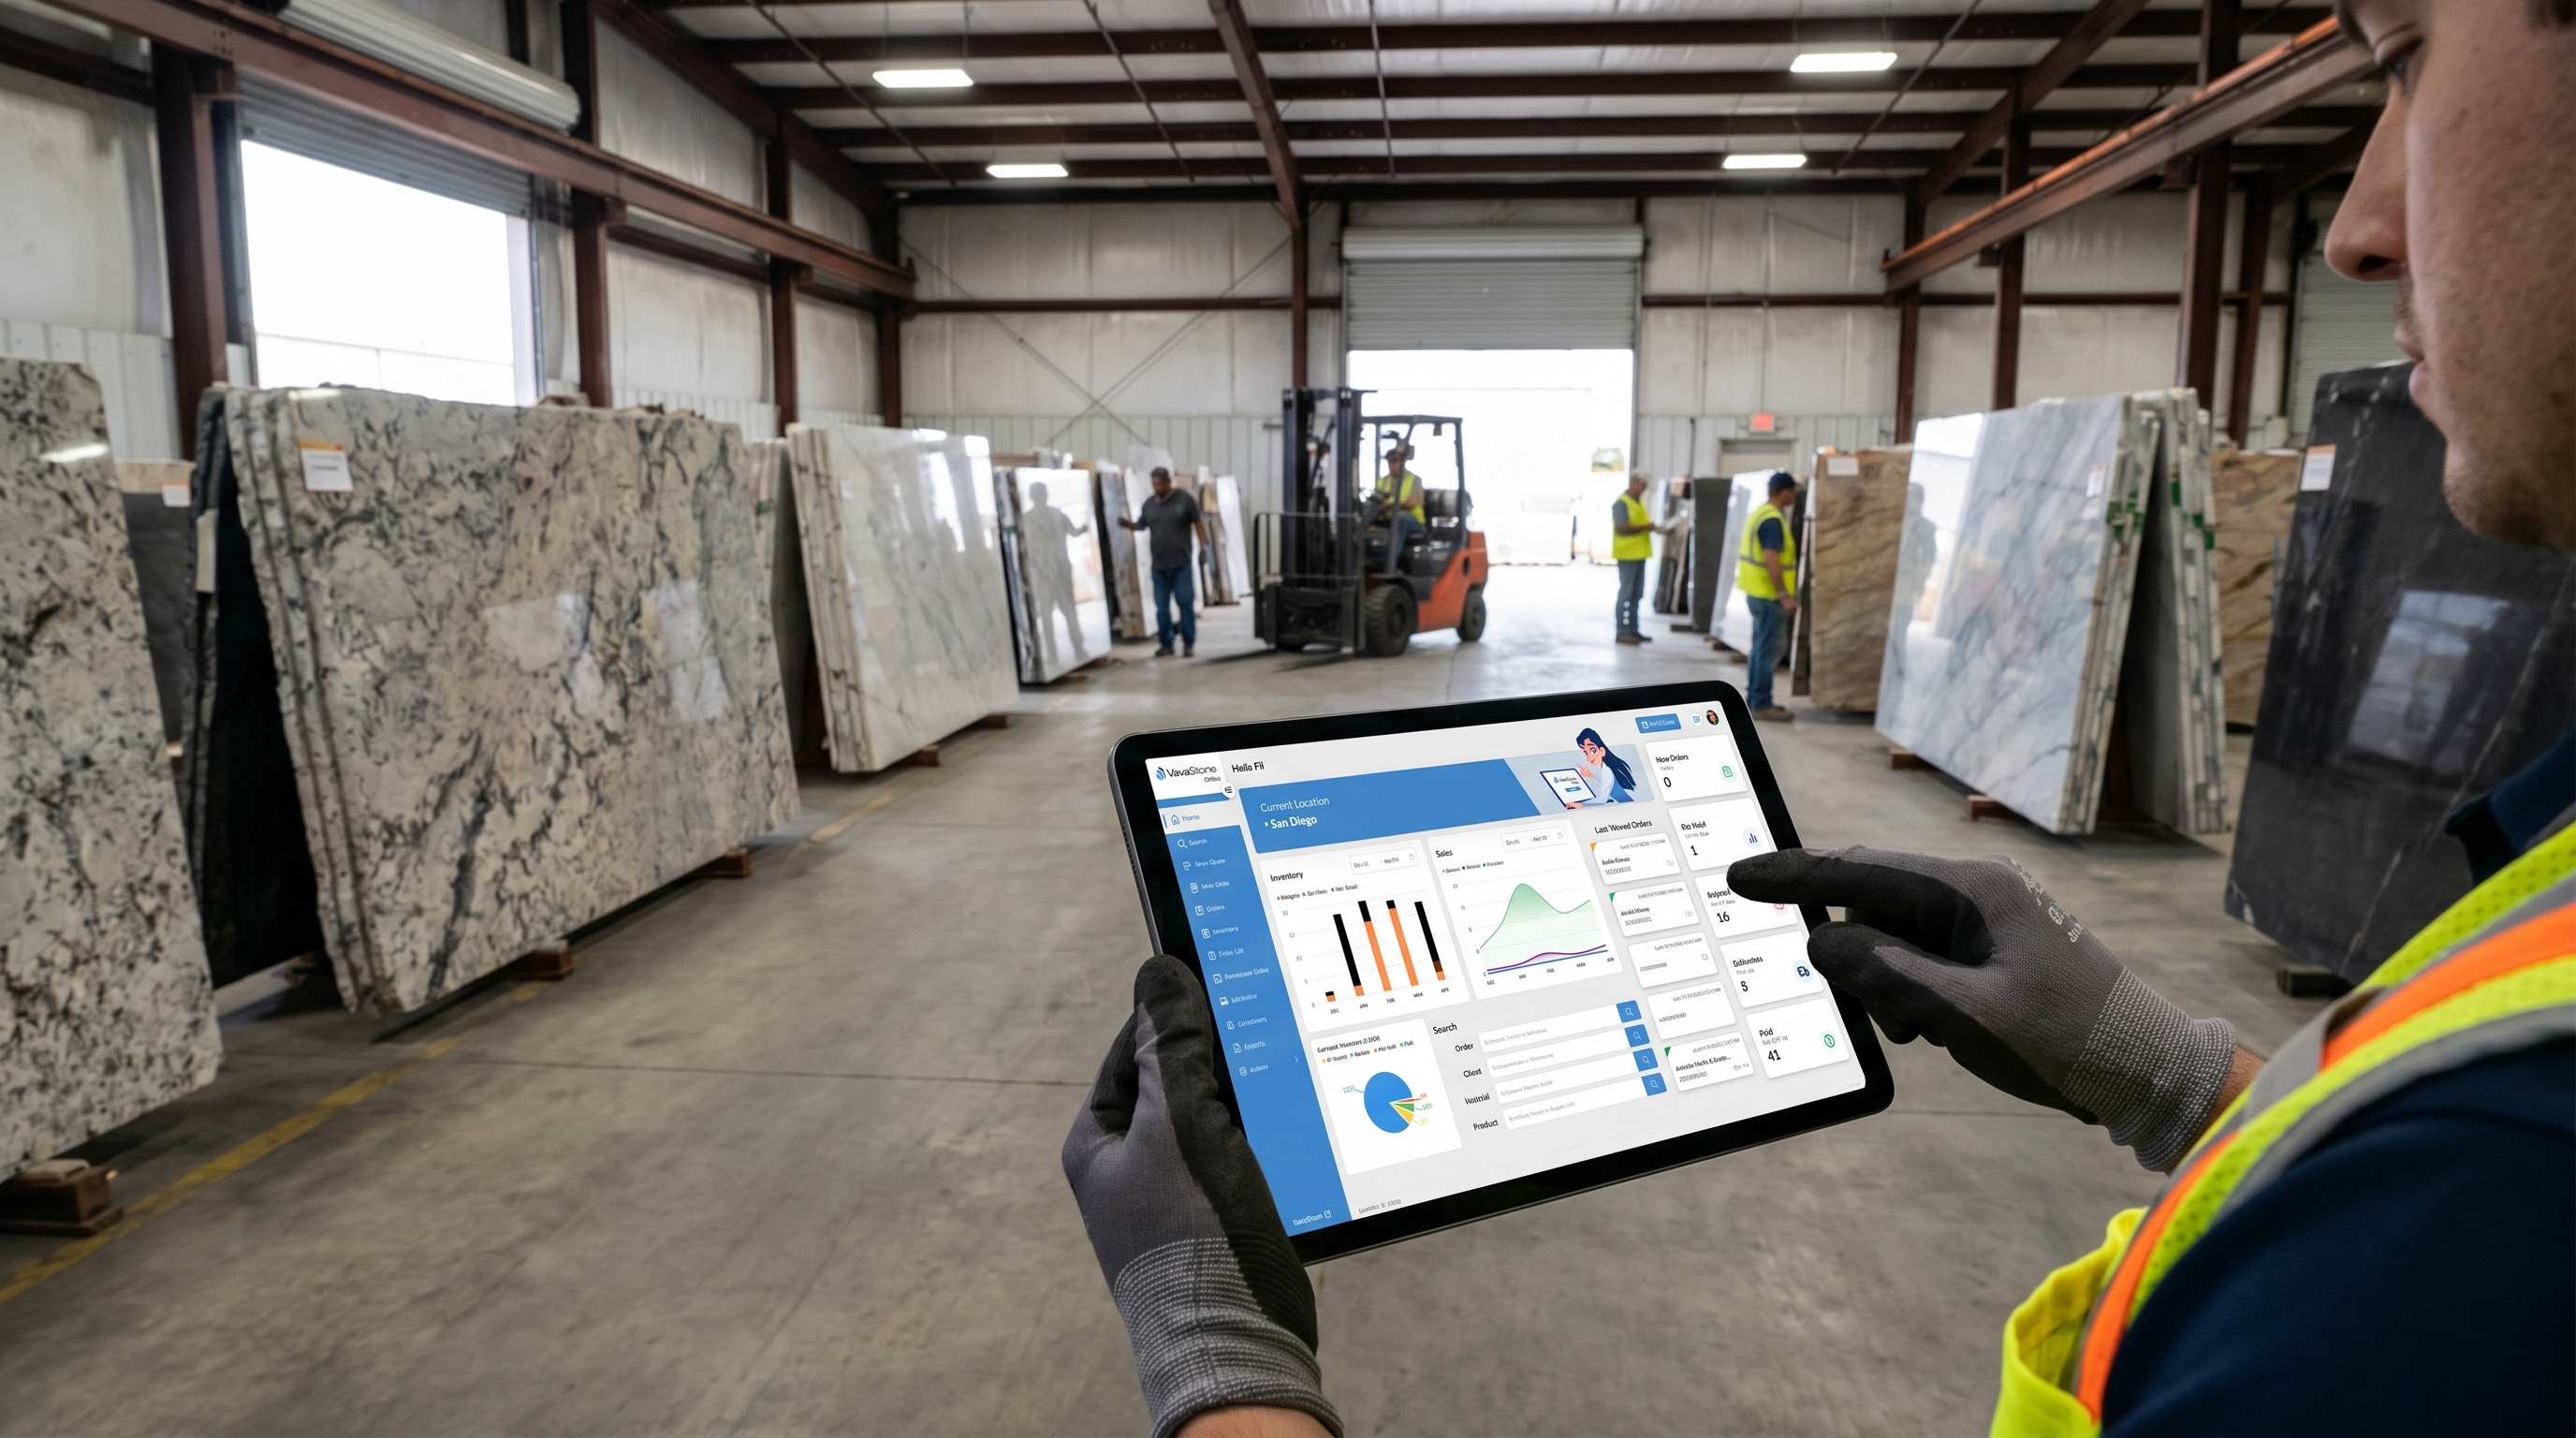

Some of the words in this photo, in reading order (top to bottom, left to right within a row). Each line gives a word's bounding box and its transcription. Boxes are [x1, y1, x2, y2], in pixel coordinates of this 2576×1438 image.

[1232, 762, 1253, 773] Hello
[1663, 777, 1672, 787] 0
[1260, 801, 1293, 813] Current
[1294, 797, 1330, 809] Location
[1270, 817, 1292, 829] San
[1292, 815, 1318, 828] Diego
[1435, 849, 1454, 858] Sales
[1690, 845, 1698, 856] 1
[1270, 871, 1304, 882] Inventory
[1716, 911, 1731, 923] 16
[1432, 1022, 1457, 1034] Search
[1455, 1042, 1474, 1052] Order
[1767, 1049, 1781, 1062] 41
